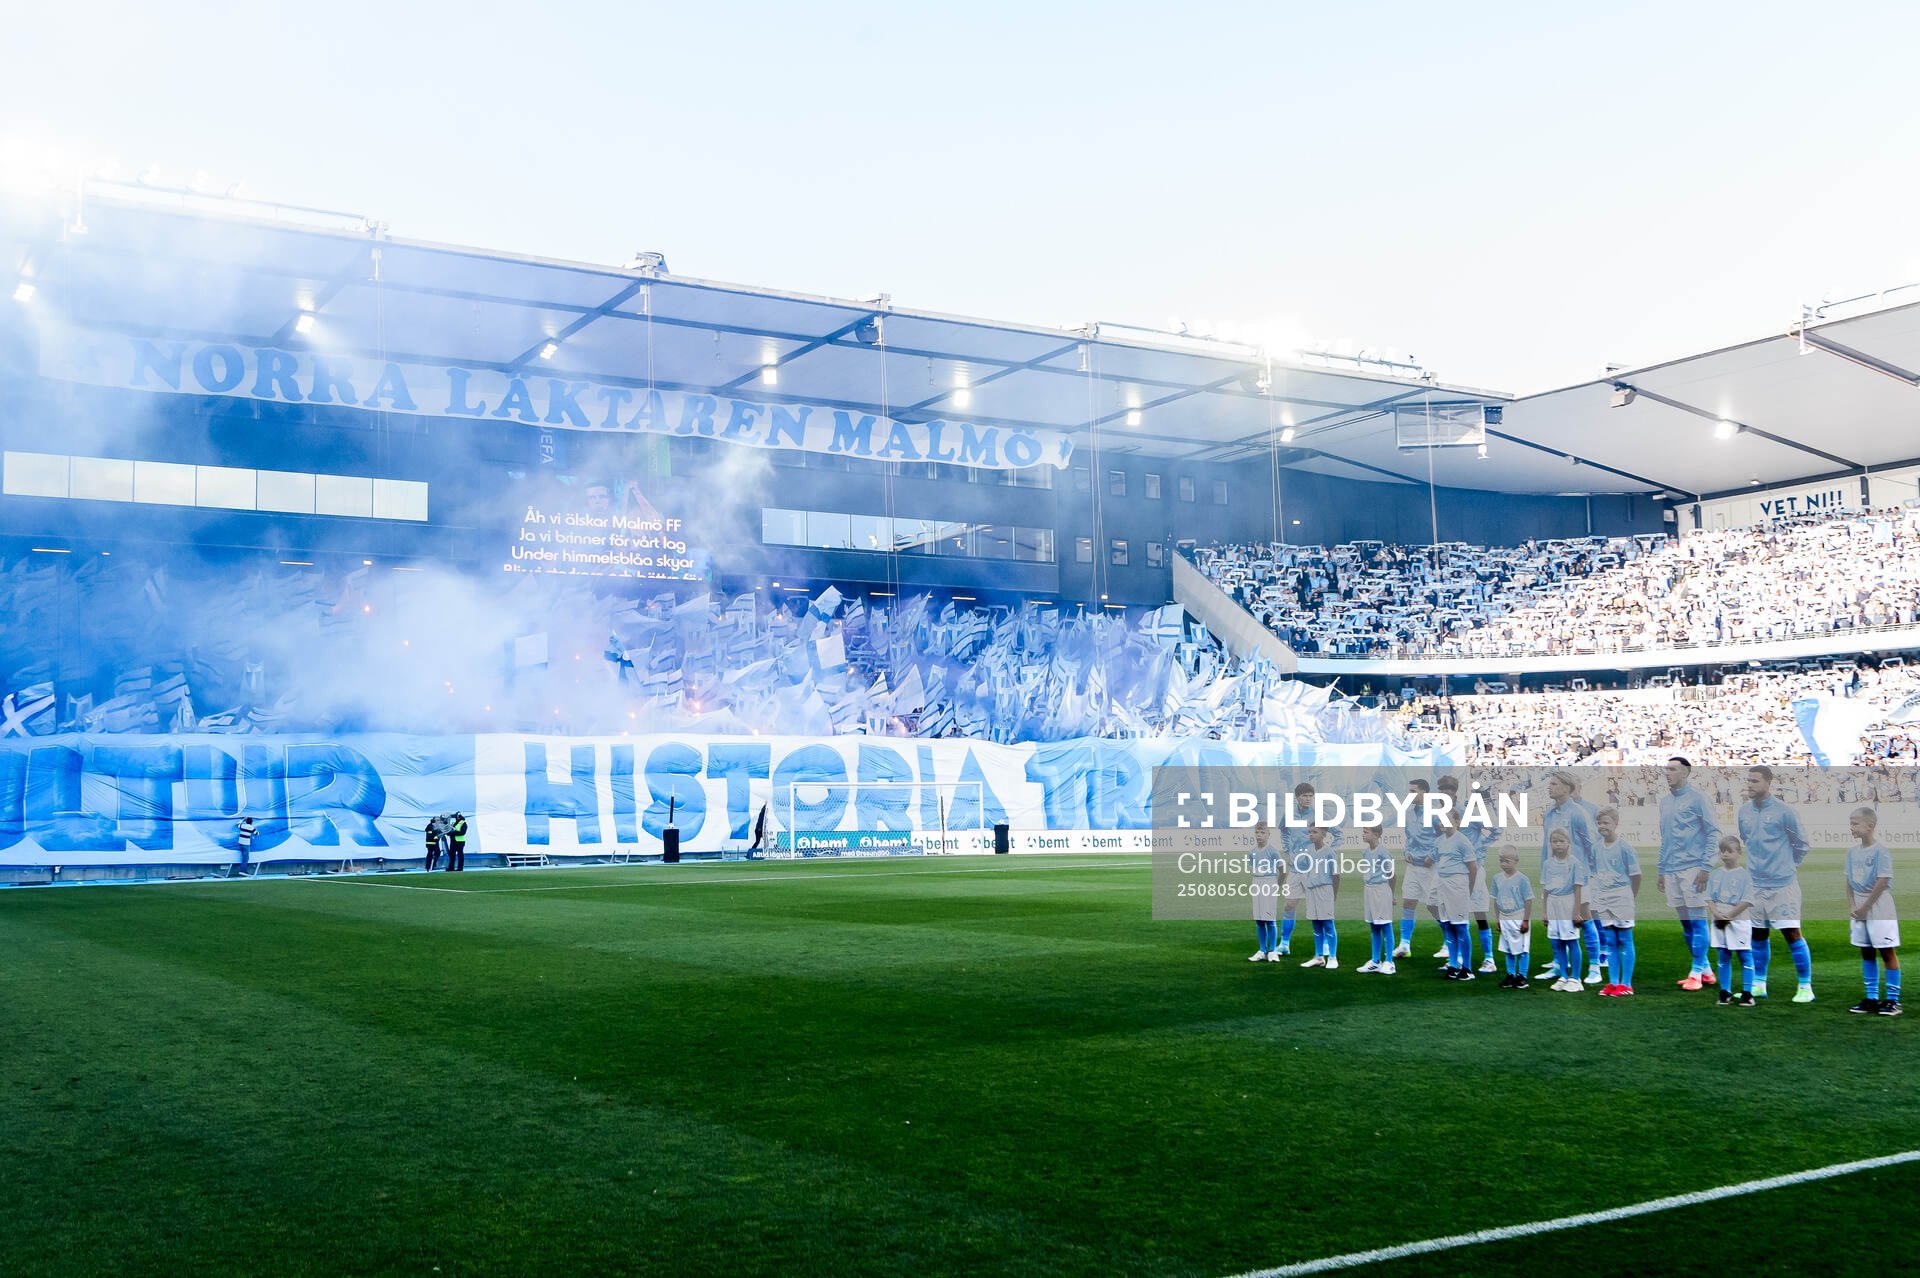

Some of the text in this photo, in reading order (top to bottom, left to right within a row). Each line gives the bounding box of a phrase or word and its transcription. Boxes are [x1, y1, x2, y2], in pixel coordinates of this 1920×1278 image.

[129, 340, 1043, 467] NORRA LÄKTAREN MALMÖ
[1760, 490, 1842, 516] VET NI!!
[524, 506, 682, 533] Åh vi älskar Malmö FF
[519, 528, 687, 554] Ja vi brinner för vårt lag
[511, 546, 695, 572] Under himmelsblåa skyar
[524, 742, 1009, 845] HISTORIA
[1092, 836, 1123, 848] bemt
[1143, 835, 1174, 847] bemt
[1194, 834, 1222, 847] bemt
[1505, 831, 1539, 842] bemt
[1619, 831, 1641, 842] emt
[1824, 829, 1853, 842] bem
[983, 836, 1016, 849] bet
[1038, 836, 1070, 849] bemt
